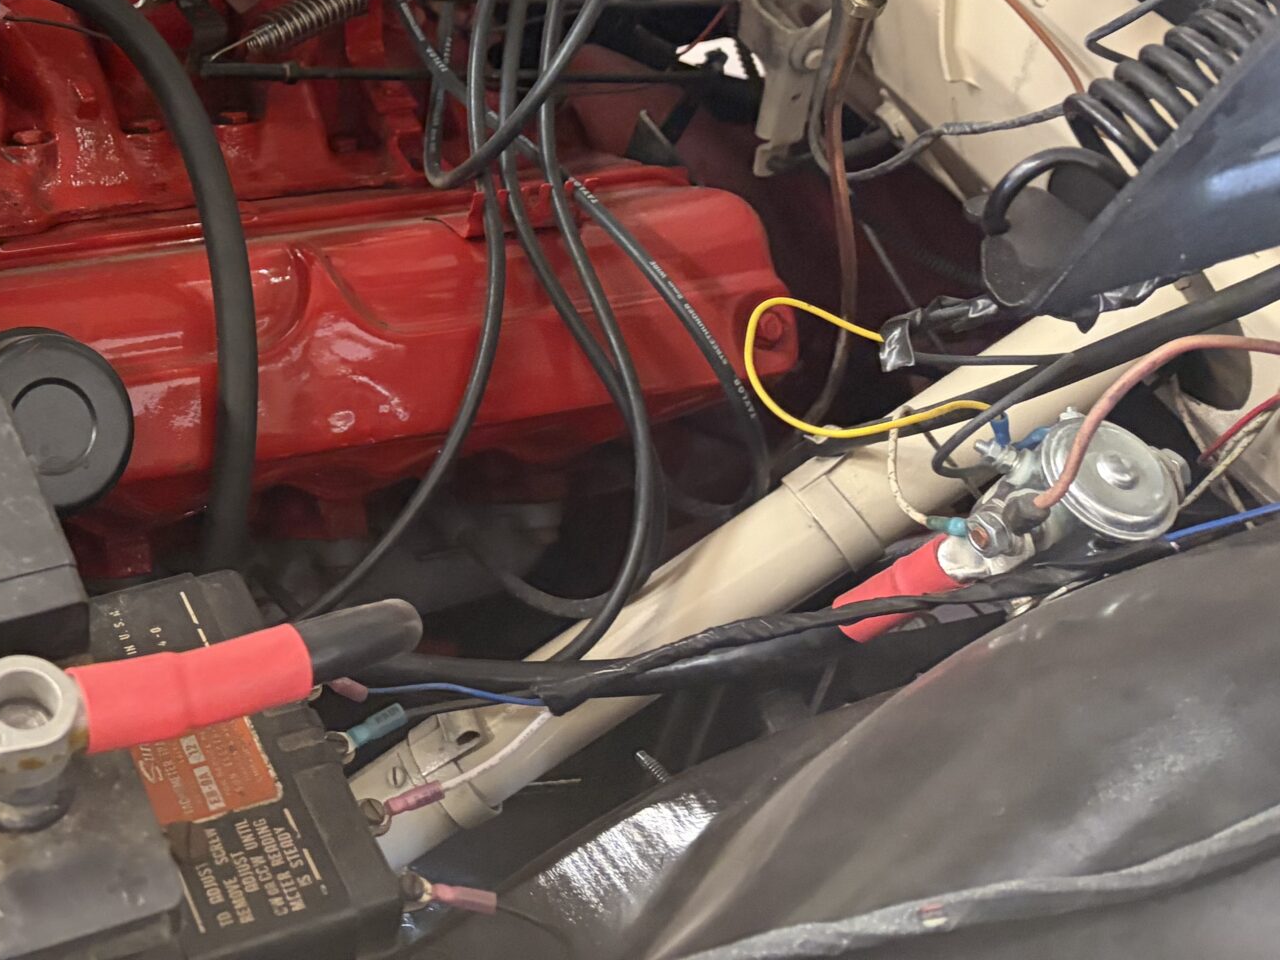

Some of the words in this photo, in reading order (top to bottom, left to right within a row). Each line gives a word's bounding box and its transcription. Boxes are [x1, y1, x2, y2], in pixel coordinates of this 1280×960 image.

[733, 378, 757, 419] TAYLOR
[233, 817, 258, 850] UNTIL
[252, 817, 285, 867] READING
[273, 824, 304, 868] STEADY
[195, 862, 224, 904] ADJUST
[230, 849, 259, 893] ADJUST
[249, 853, 273, 882] CCW
[296, 873, 312, 887] IS
[222, 876, 255, 924] REMOVE
